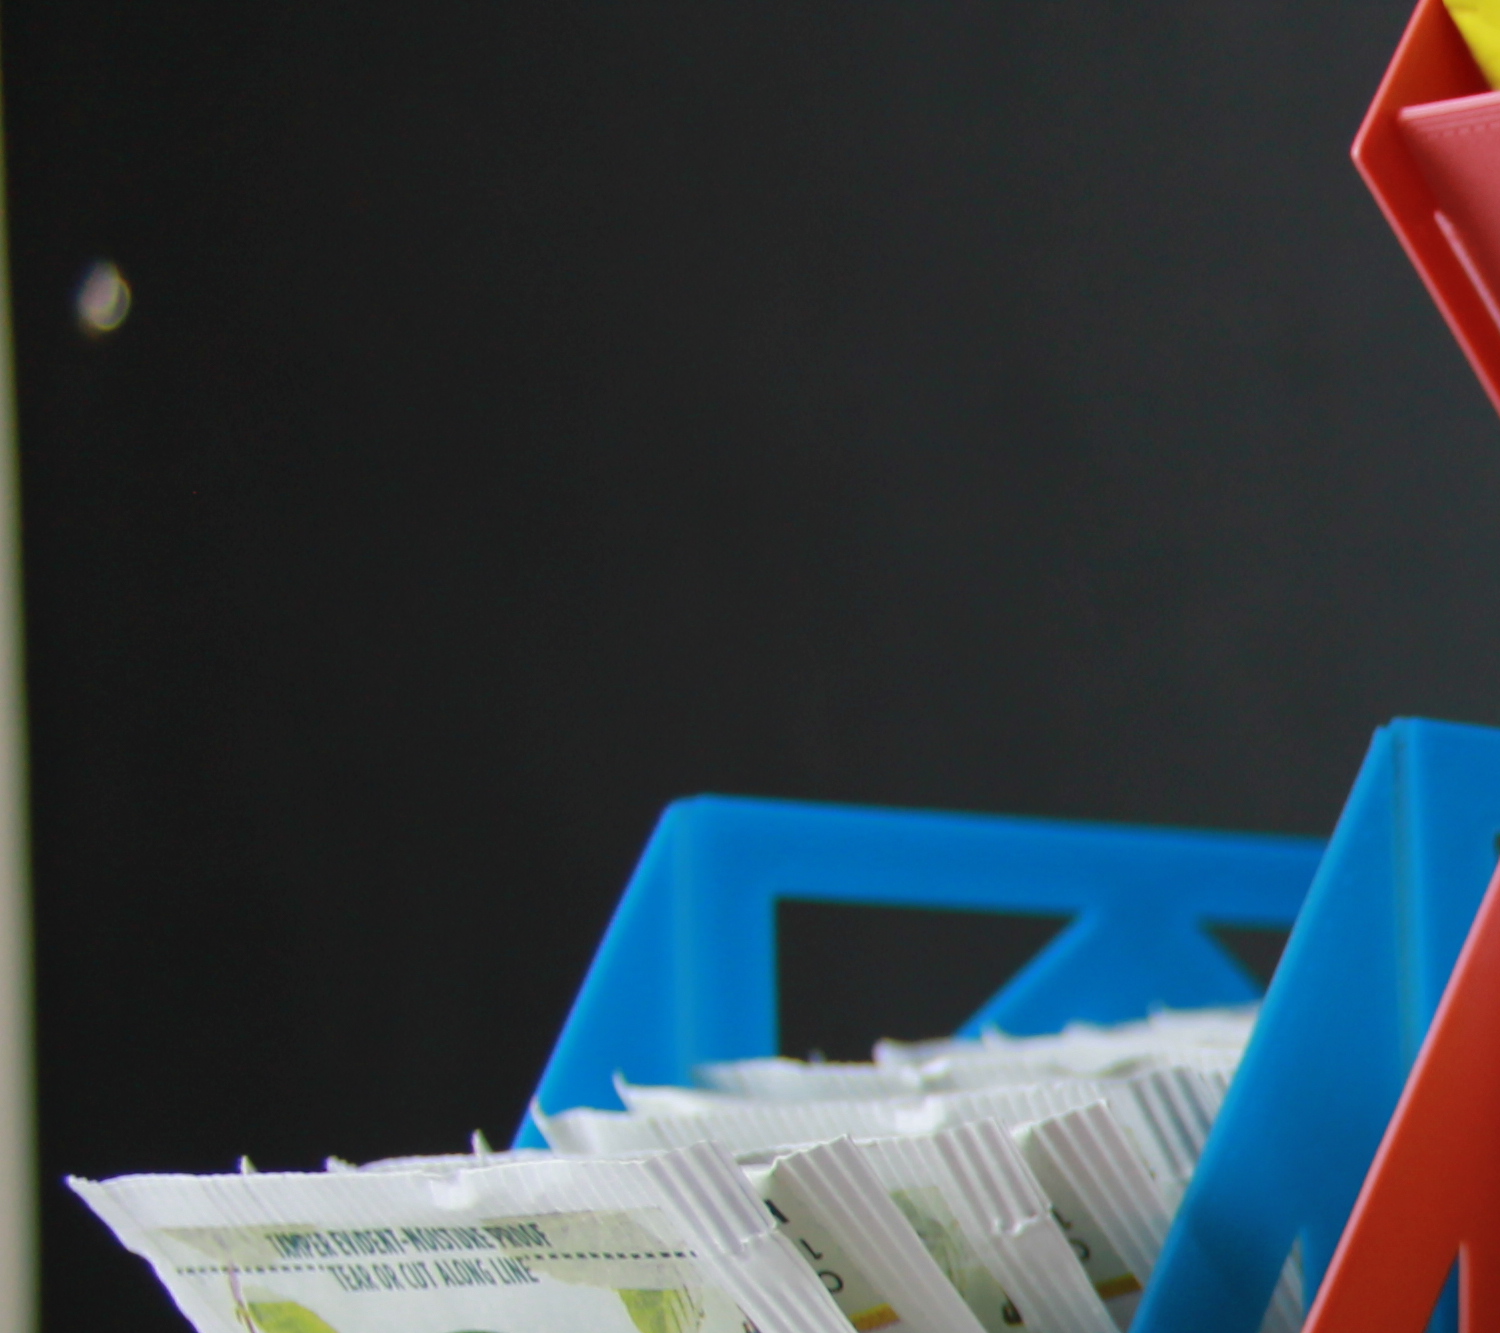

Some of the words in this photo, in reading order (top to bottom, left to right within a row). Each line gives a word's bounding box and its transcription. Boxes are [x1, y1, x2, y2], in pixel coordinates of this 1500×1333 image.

[264, 1230, 334, 1261] TAMPER
[487, 1221, 552, 1249] PROOF
[328, 1262, 381, 1292] TEAR
[373, 1262, 402, 1291] OR
[399, 1261, 438, 1291] CUT
[434, 1259, 497, 1287] ALONG
[489, 1256, 540, 1284] LINE
